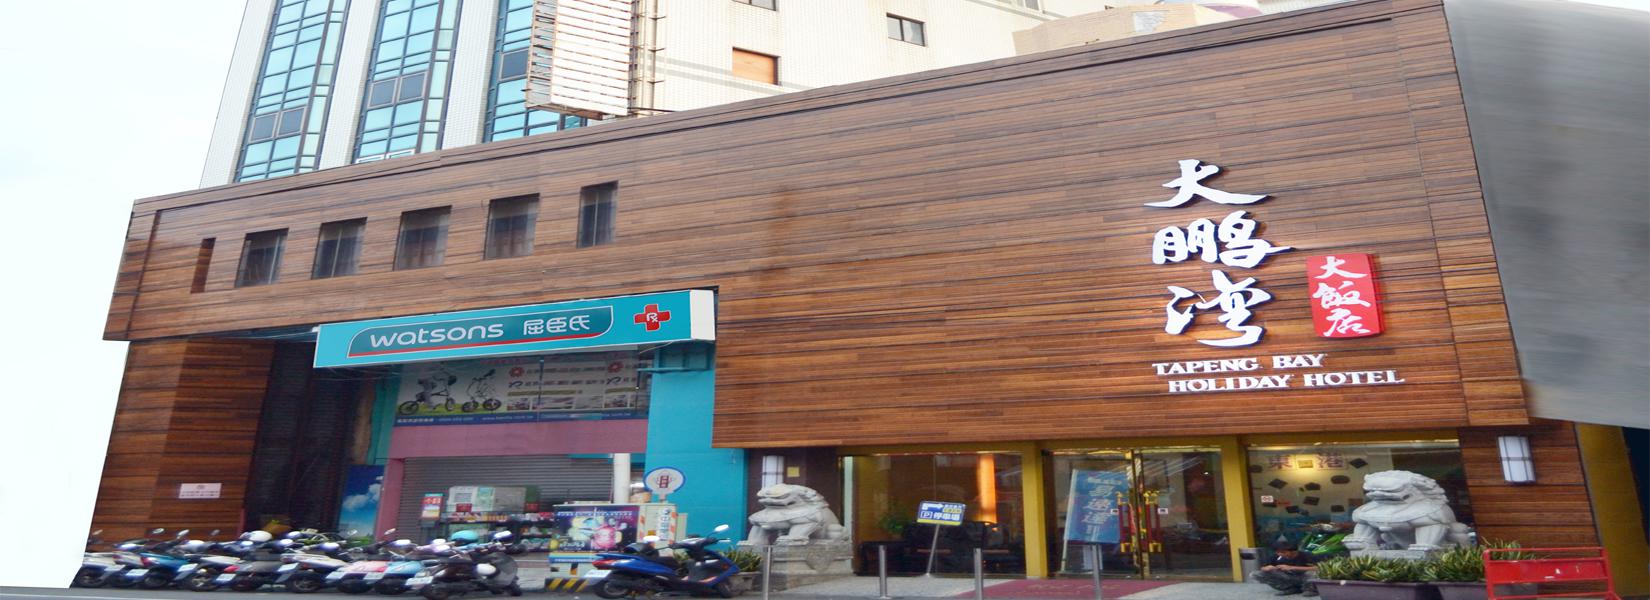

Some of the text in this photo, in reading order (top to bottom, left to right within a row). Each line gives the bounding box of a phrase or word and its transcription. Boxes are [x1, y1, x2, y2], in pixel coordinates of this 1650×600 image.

[1144, 159, 1293, 347] 大鵬灣
[1312, 256, 1371, 337] 大飯店
[369, 313, 591, 348] watsons 屈臣氏
[1152, 353, 1326, 376] TAPENG BAY
[1168, 369, 1405, 393] HOLIDAY HOTEL
